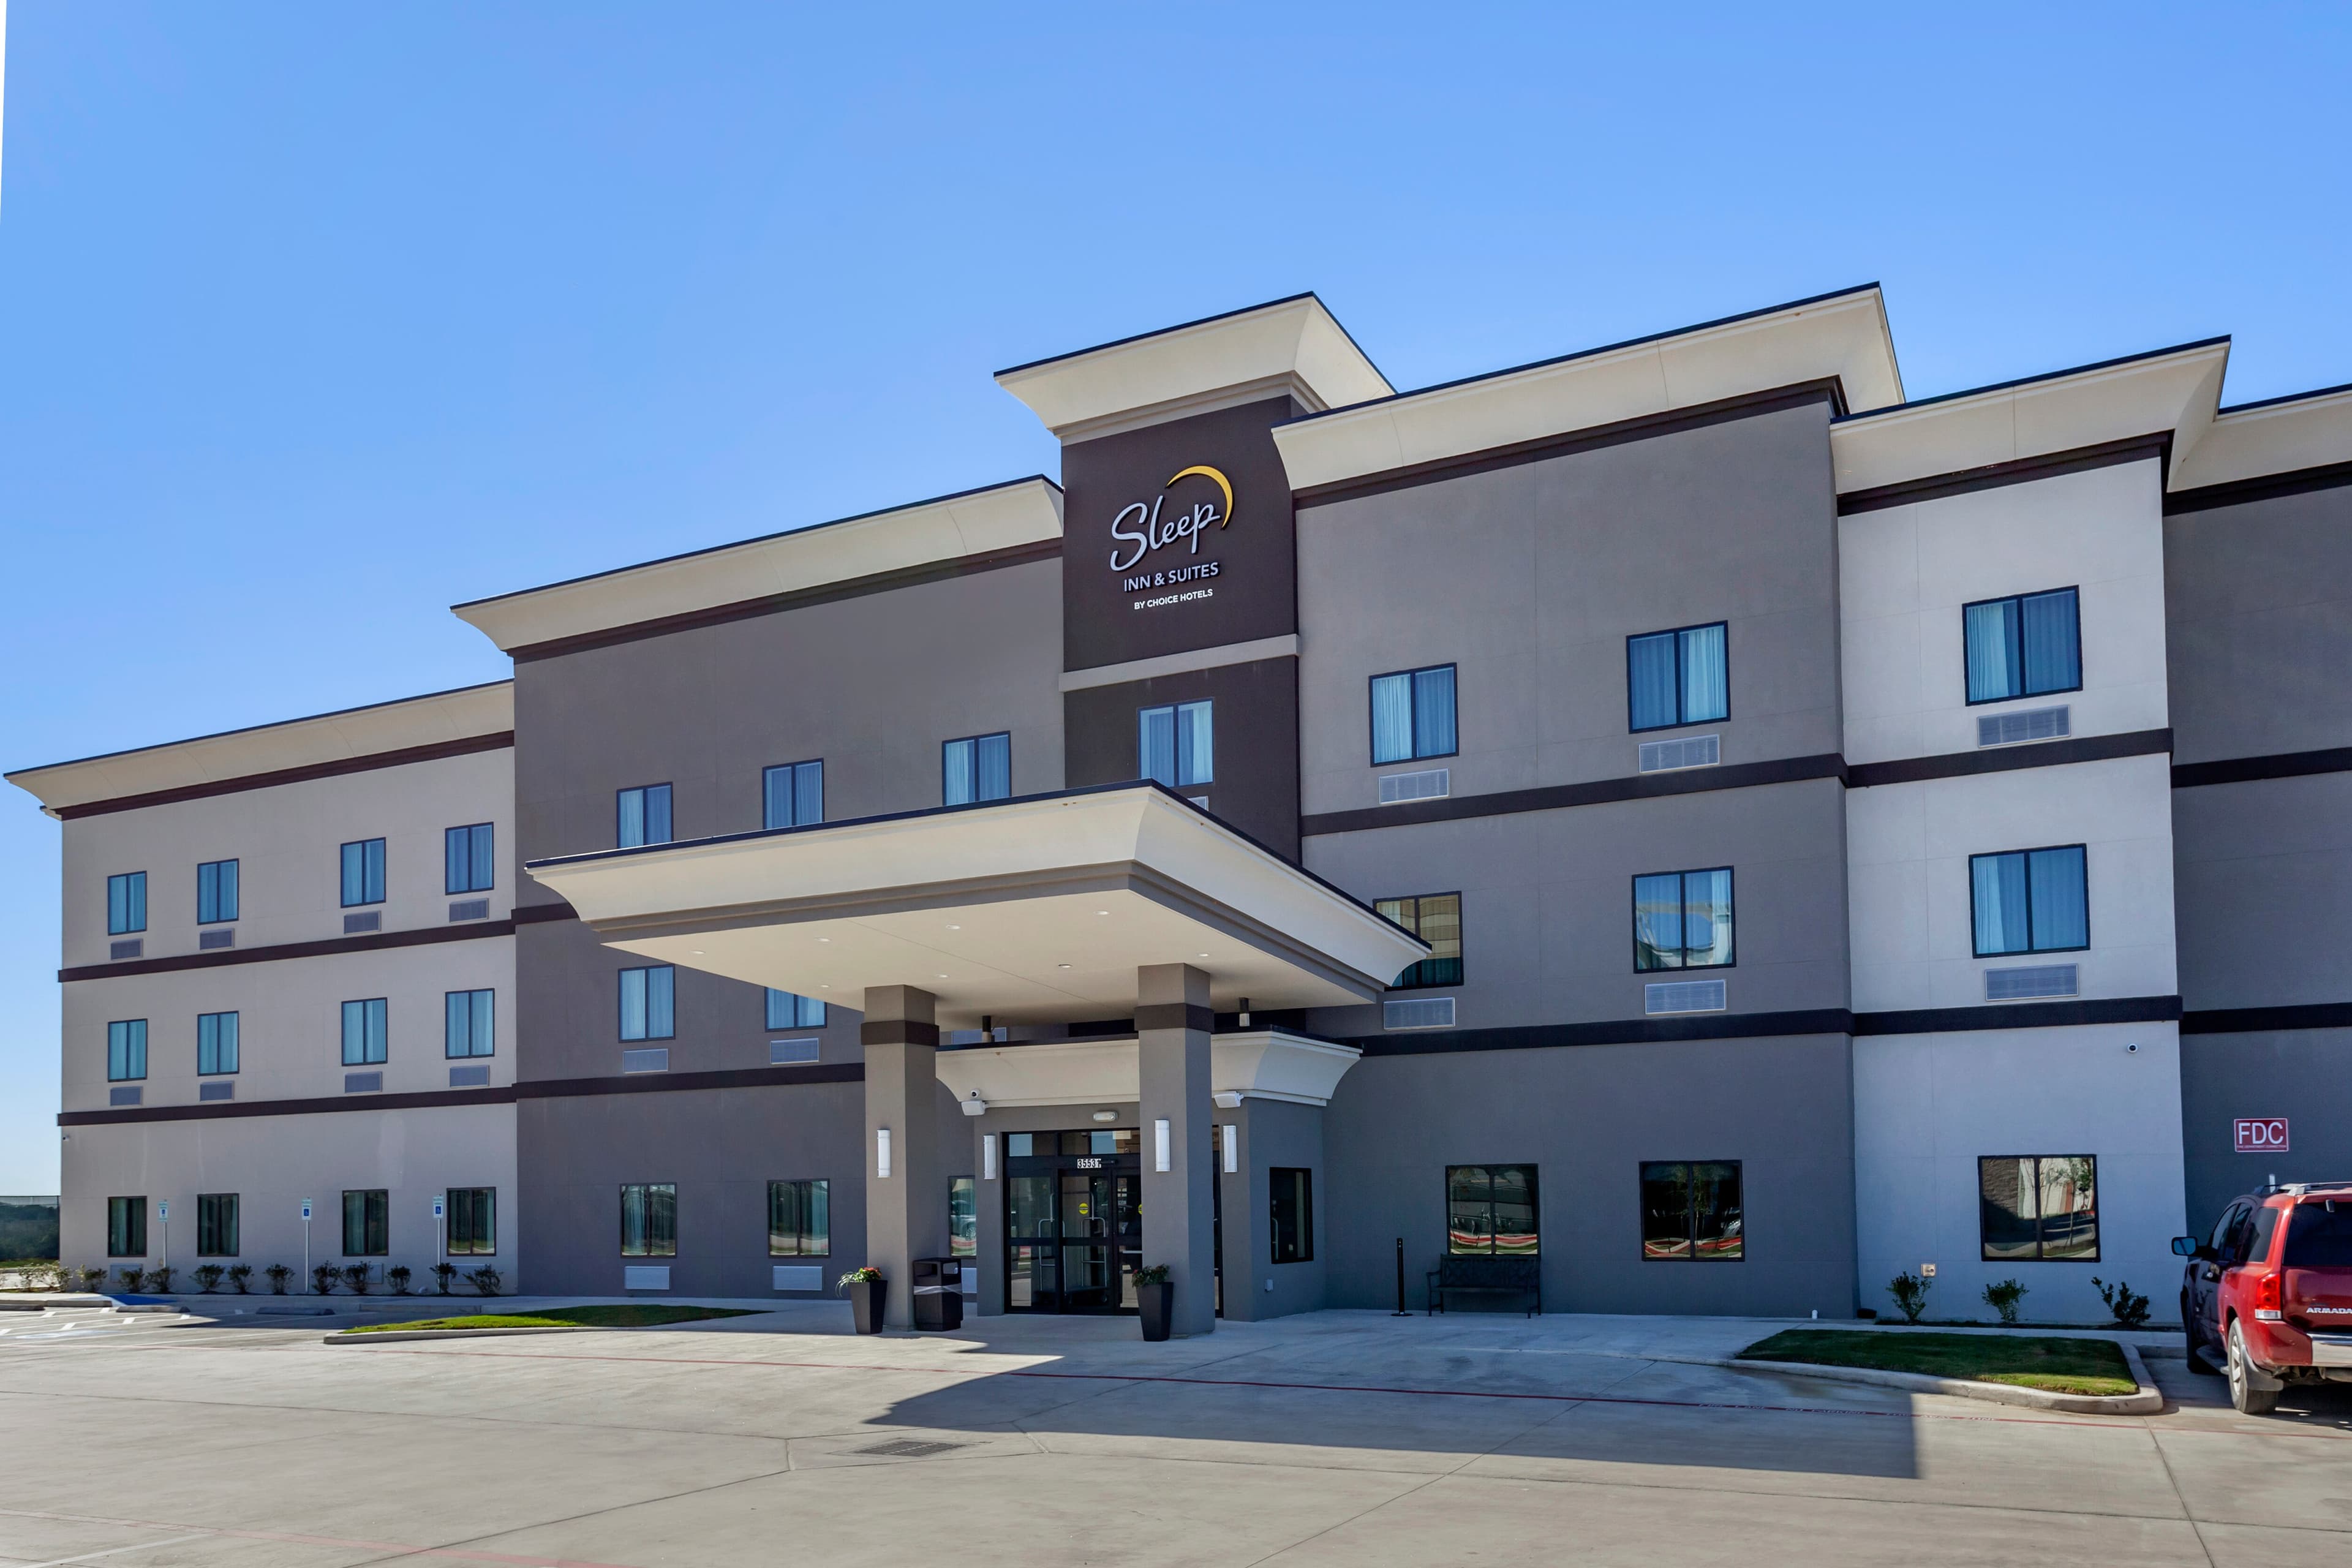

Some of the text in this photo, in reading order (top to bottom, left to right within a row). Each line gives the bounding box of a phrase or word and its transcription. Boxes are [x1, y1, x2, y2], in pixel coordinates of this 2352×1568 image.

[1110, 496, 1221, 571] Sleep
[1124, 562, 1219, 592] INN & SUITES
[1134, 588, 1213, 610] BY CHOICE HOTELS
[2239, 1121, 2284, 1144] FDC
